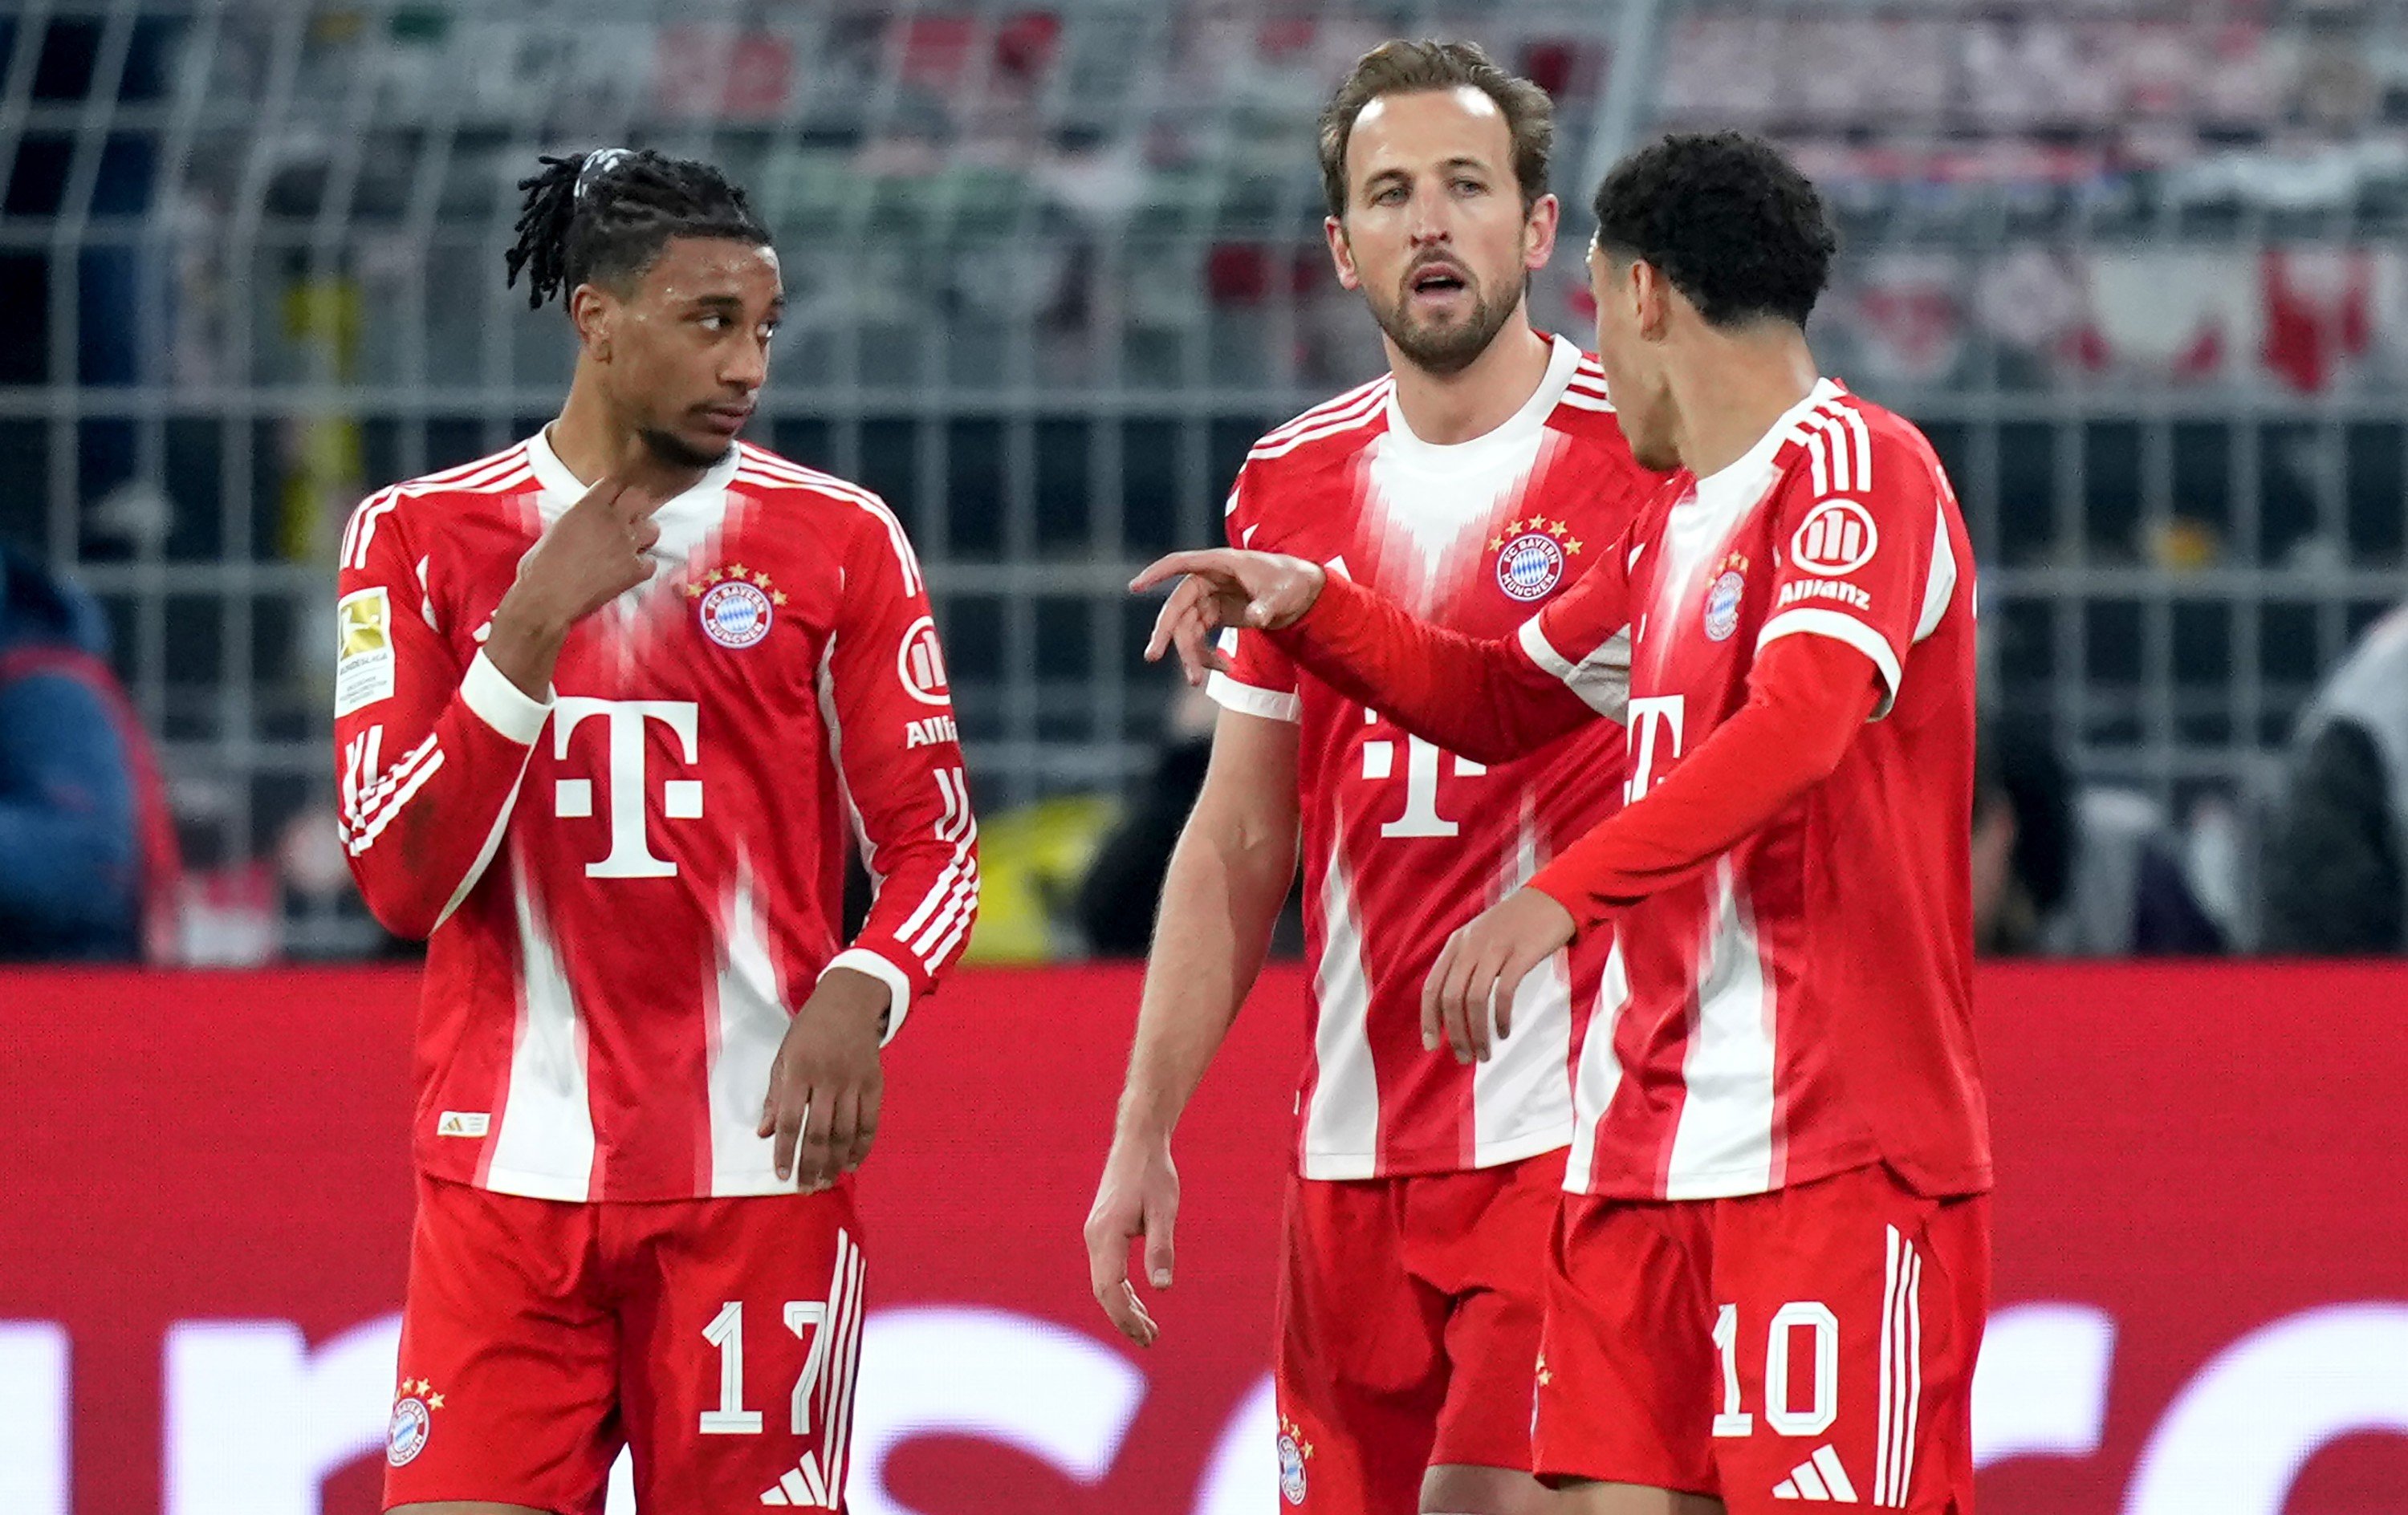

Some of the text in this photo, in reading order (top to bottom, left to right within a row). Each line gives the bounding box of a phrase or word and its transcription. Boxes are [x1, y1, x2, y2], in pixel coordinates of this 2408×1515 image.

[1503, 538, 1559, 564] FC BAYERN
[721, 586, 767, 613] BAYERN
[1776, 579, 1871, 611] Allianz
[554, 696, 699, 878] T
[700, 1301, 828, 1435] 17
[1711, 1301, 1838, 1437] 10
